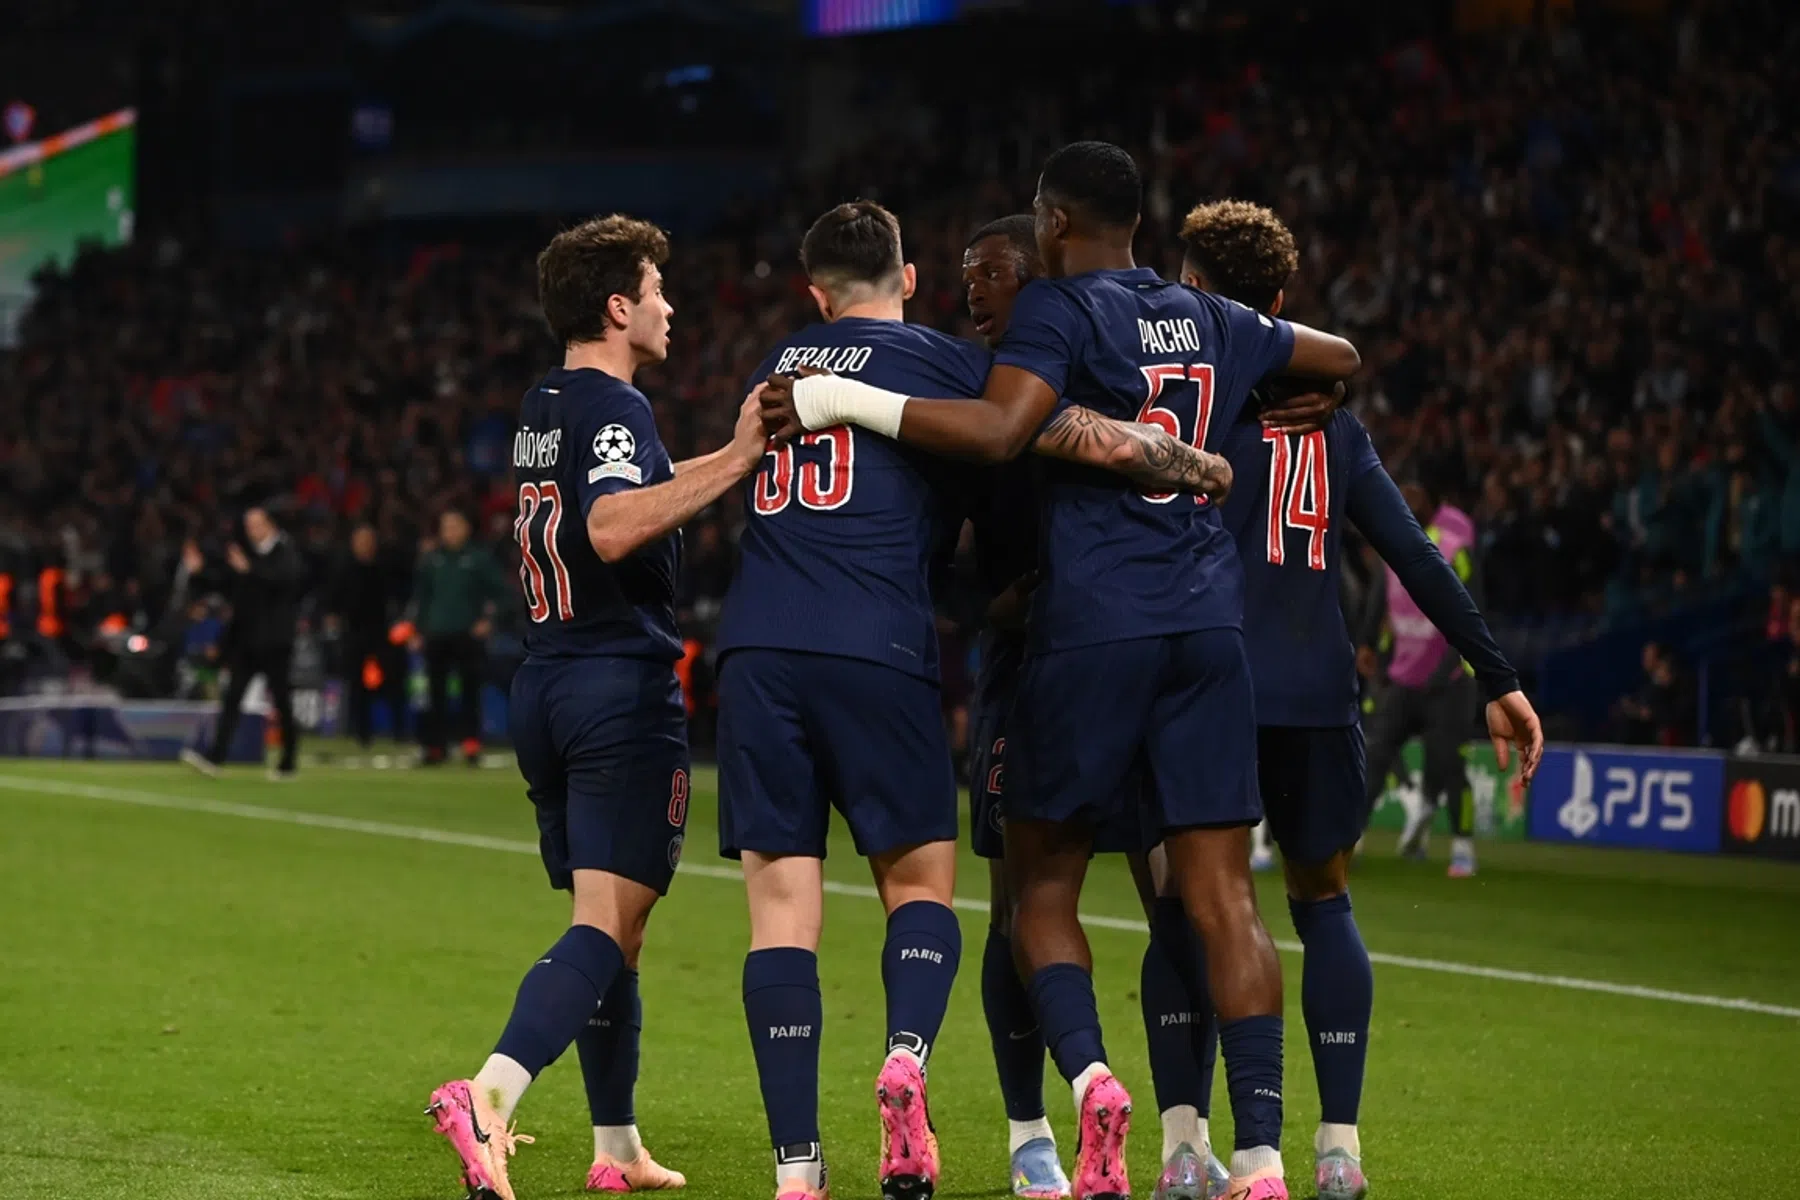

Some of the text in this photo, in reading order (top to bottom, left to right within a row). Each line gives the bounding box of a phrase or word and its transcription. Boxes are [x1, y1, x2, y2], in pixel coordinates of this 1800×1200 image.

[1137, 317, 1201, 354] PACHO
[775, 346, 873, 374] BERALDO
[1262, 427, 1330, 571] 14
[514, 480, 574, 623] 87
[1603, 766, 1694, 832] PS5
[900, 948, 944, 965] PARIS
[769, 1024, 812, 1040] PARIS
[1319, 1031, 1356, 1045] PARIS
